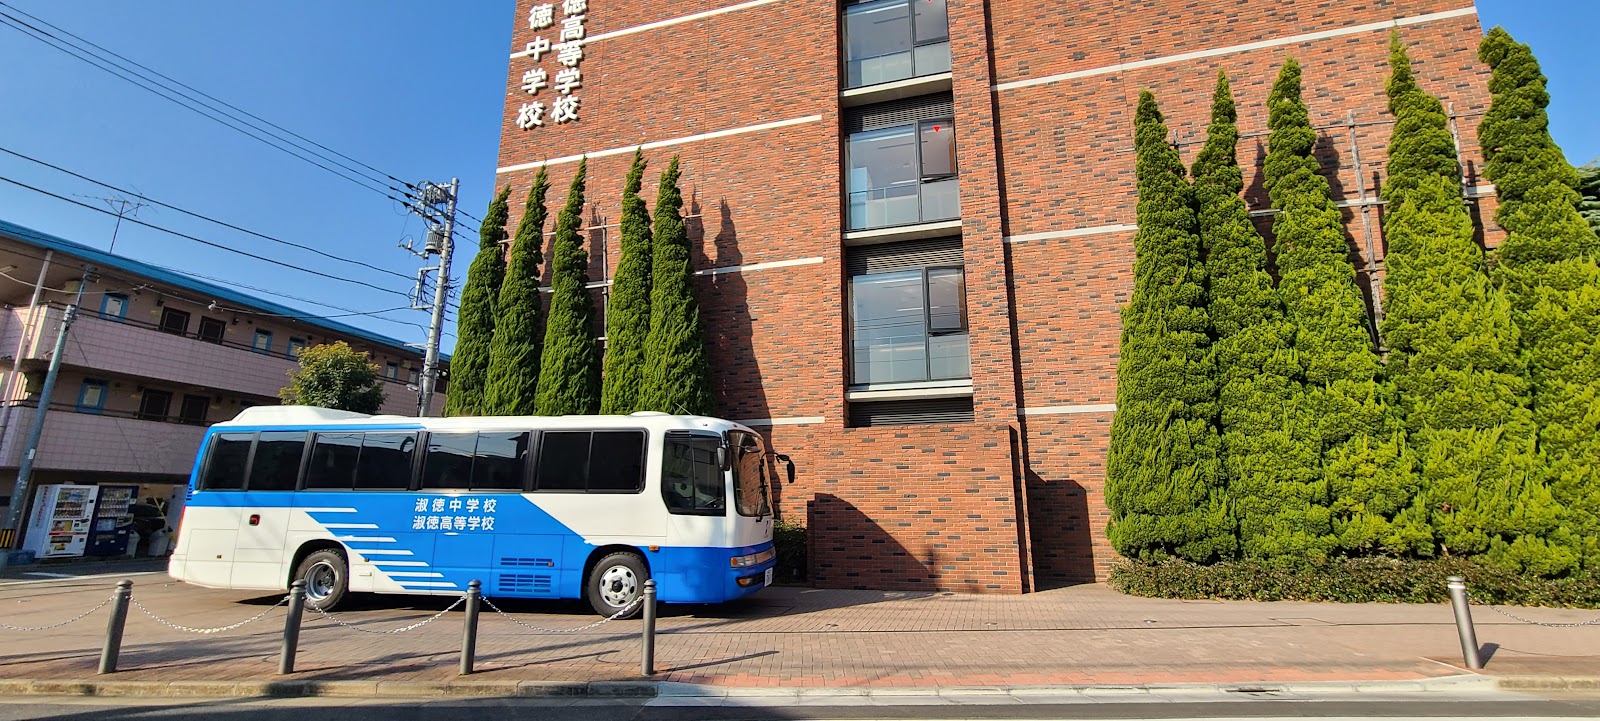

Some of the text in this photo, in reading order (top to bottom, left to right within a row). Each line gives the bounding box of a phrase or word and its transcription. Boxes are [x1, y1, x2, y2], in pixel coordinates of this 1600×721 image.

[516, 3, 554, 129] 徳中学校
[414, 498, 497, 513] 淑徳中学校
[412, 515, 495, 531] 淑徳高等学校
